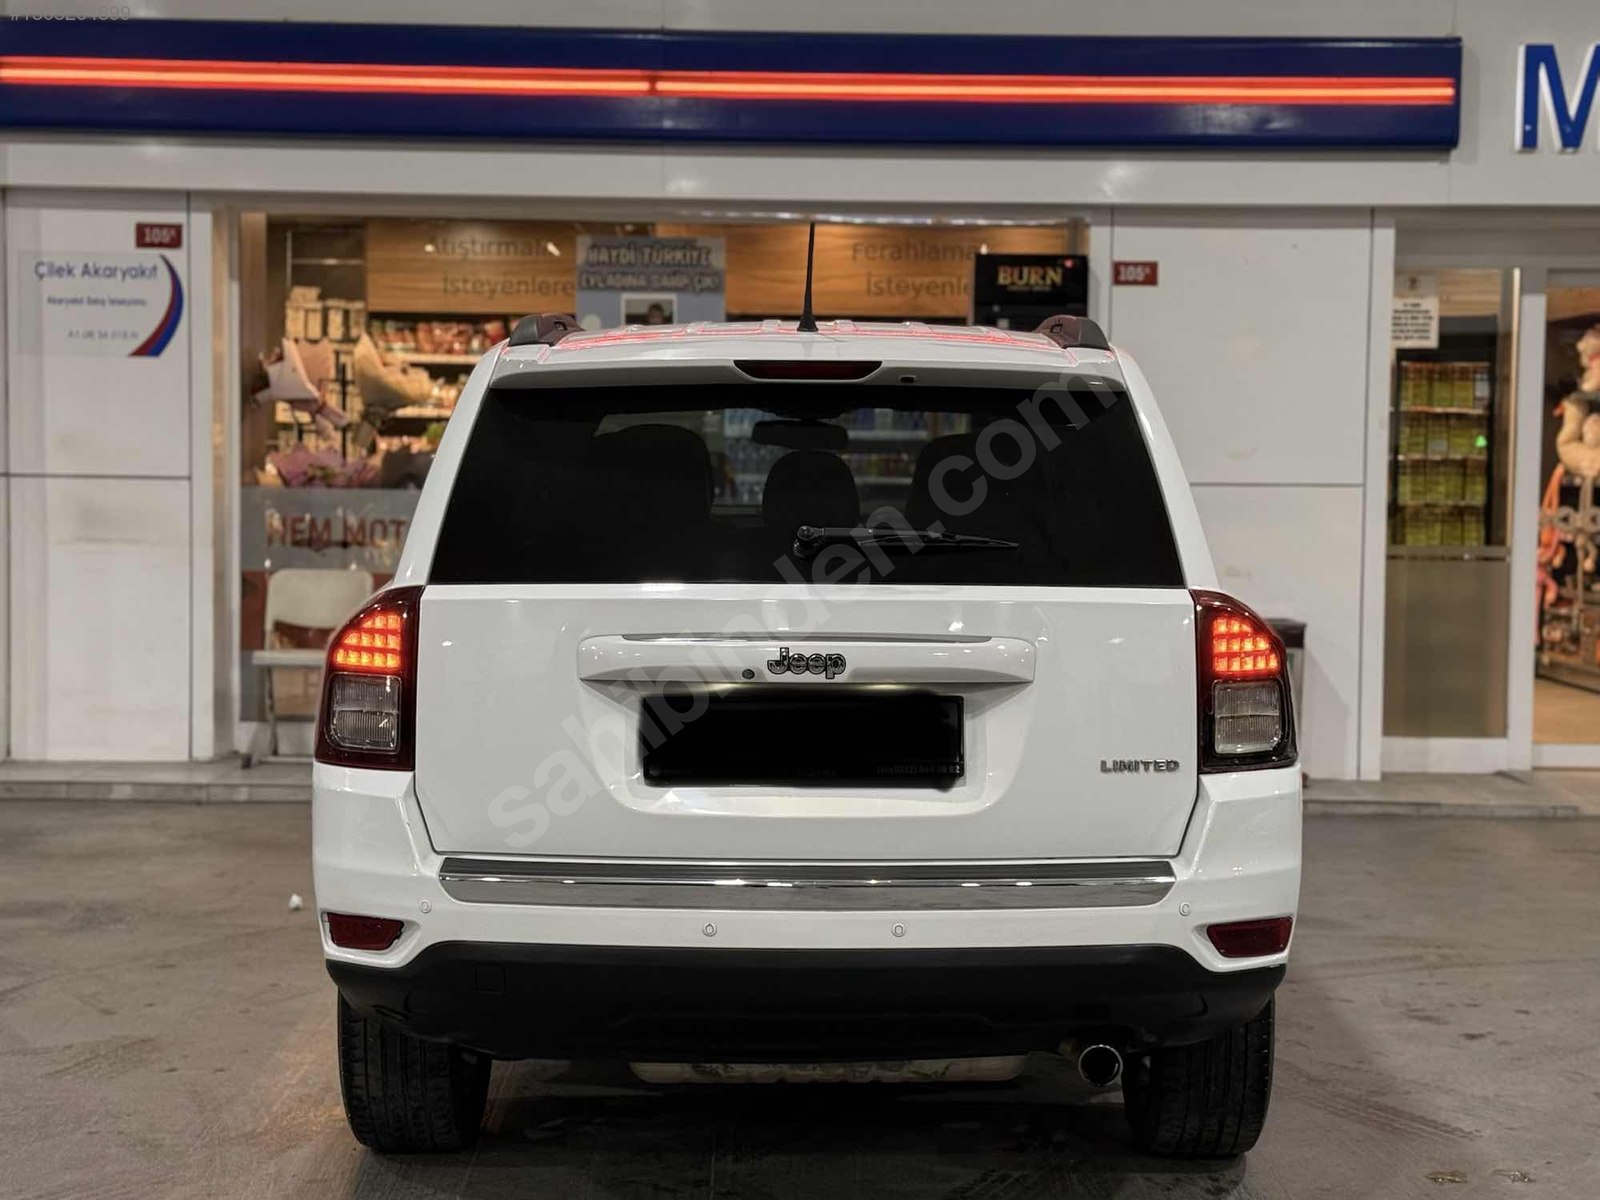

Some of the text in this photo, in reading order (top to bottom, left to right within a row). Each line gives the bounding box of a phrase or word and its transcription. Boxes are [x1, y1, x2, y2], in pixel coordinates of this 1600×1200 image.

[852, 240, 978, 262] Ferahlama
[34, 261, 75, 280] Çilek
[997, 265, 1064, 286] BURN
[767, 647, 846, 679] Jeep
[1100, 759, 1180, 772] LIMITED
